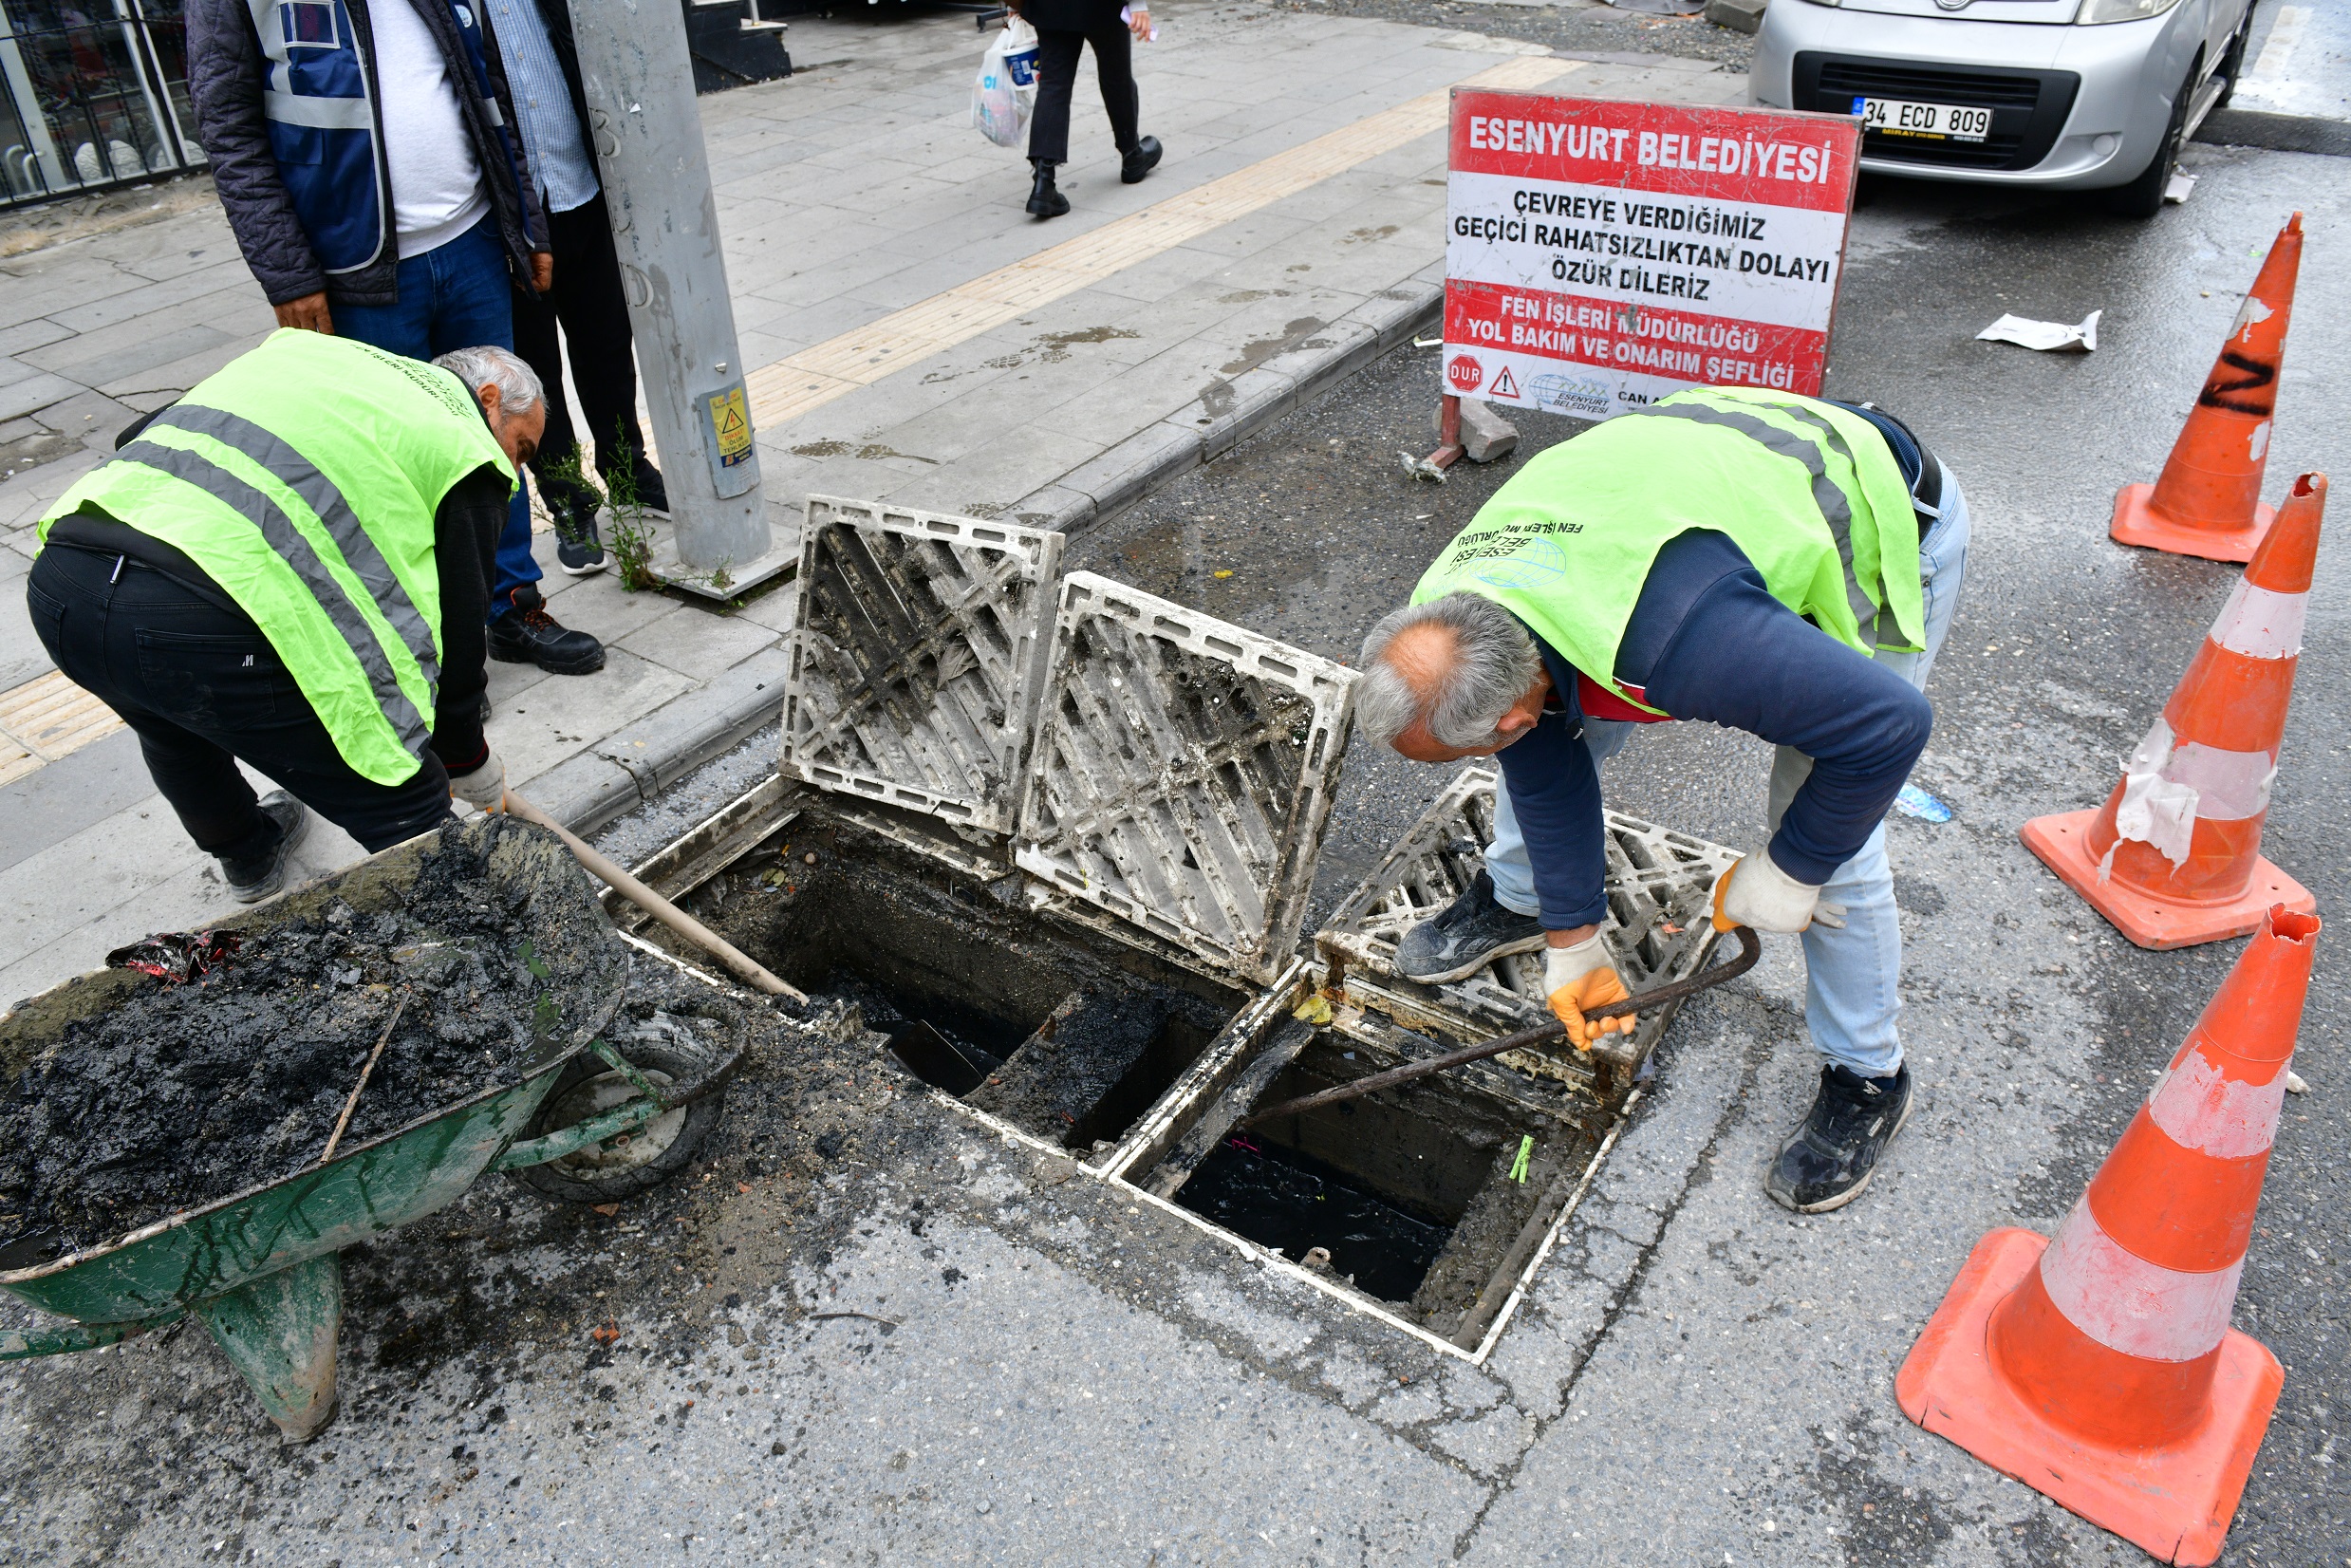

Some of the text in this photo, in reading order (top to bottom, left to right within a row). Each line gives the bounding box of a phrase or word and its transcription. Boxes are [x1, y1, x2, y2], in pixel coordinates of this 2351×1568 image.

[1866, 102, 1987, 134] 34 ECD 809
[1469, 117, 1831, 184] ESENYURT BELEDİYESİ
[1514, 190, 1765, 240] ÇEVREYE VERDİĞİMİZ
[1455, 215, 1829, 283] GEÇİCİ RAHATSIZLIKTAN DOLAYI
[1552, 254, 1710, 302] ÖZÜR DİLERİZ
[1502, 295, 1760, 354] FEN İŞLERİ MÜDÜRLÜĞÜ
[1468, 318, 1795, 389] YOL BAKIM VE ONARIM ŞEFLİĞİ
[1450, 365, 1480, 383] DUR
[1553, 400, 1609, 415] BELEDİYESİ
[1558, 393, 1609, 407] ESENYURT
[1618, 391, 1647, 404] CAN
[1558, 522, 1584, 533] FEN
